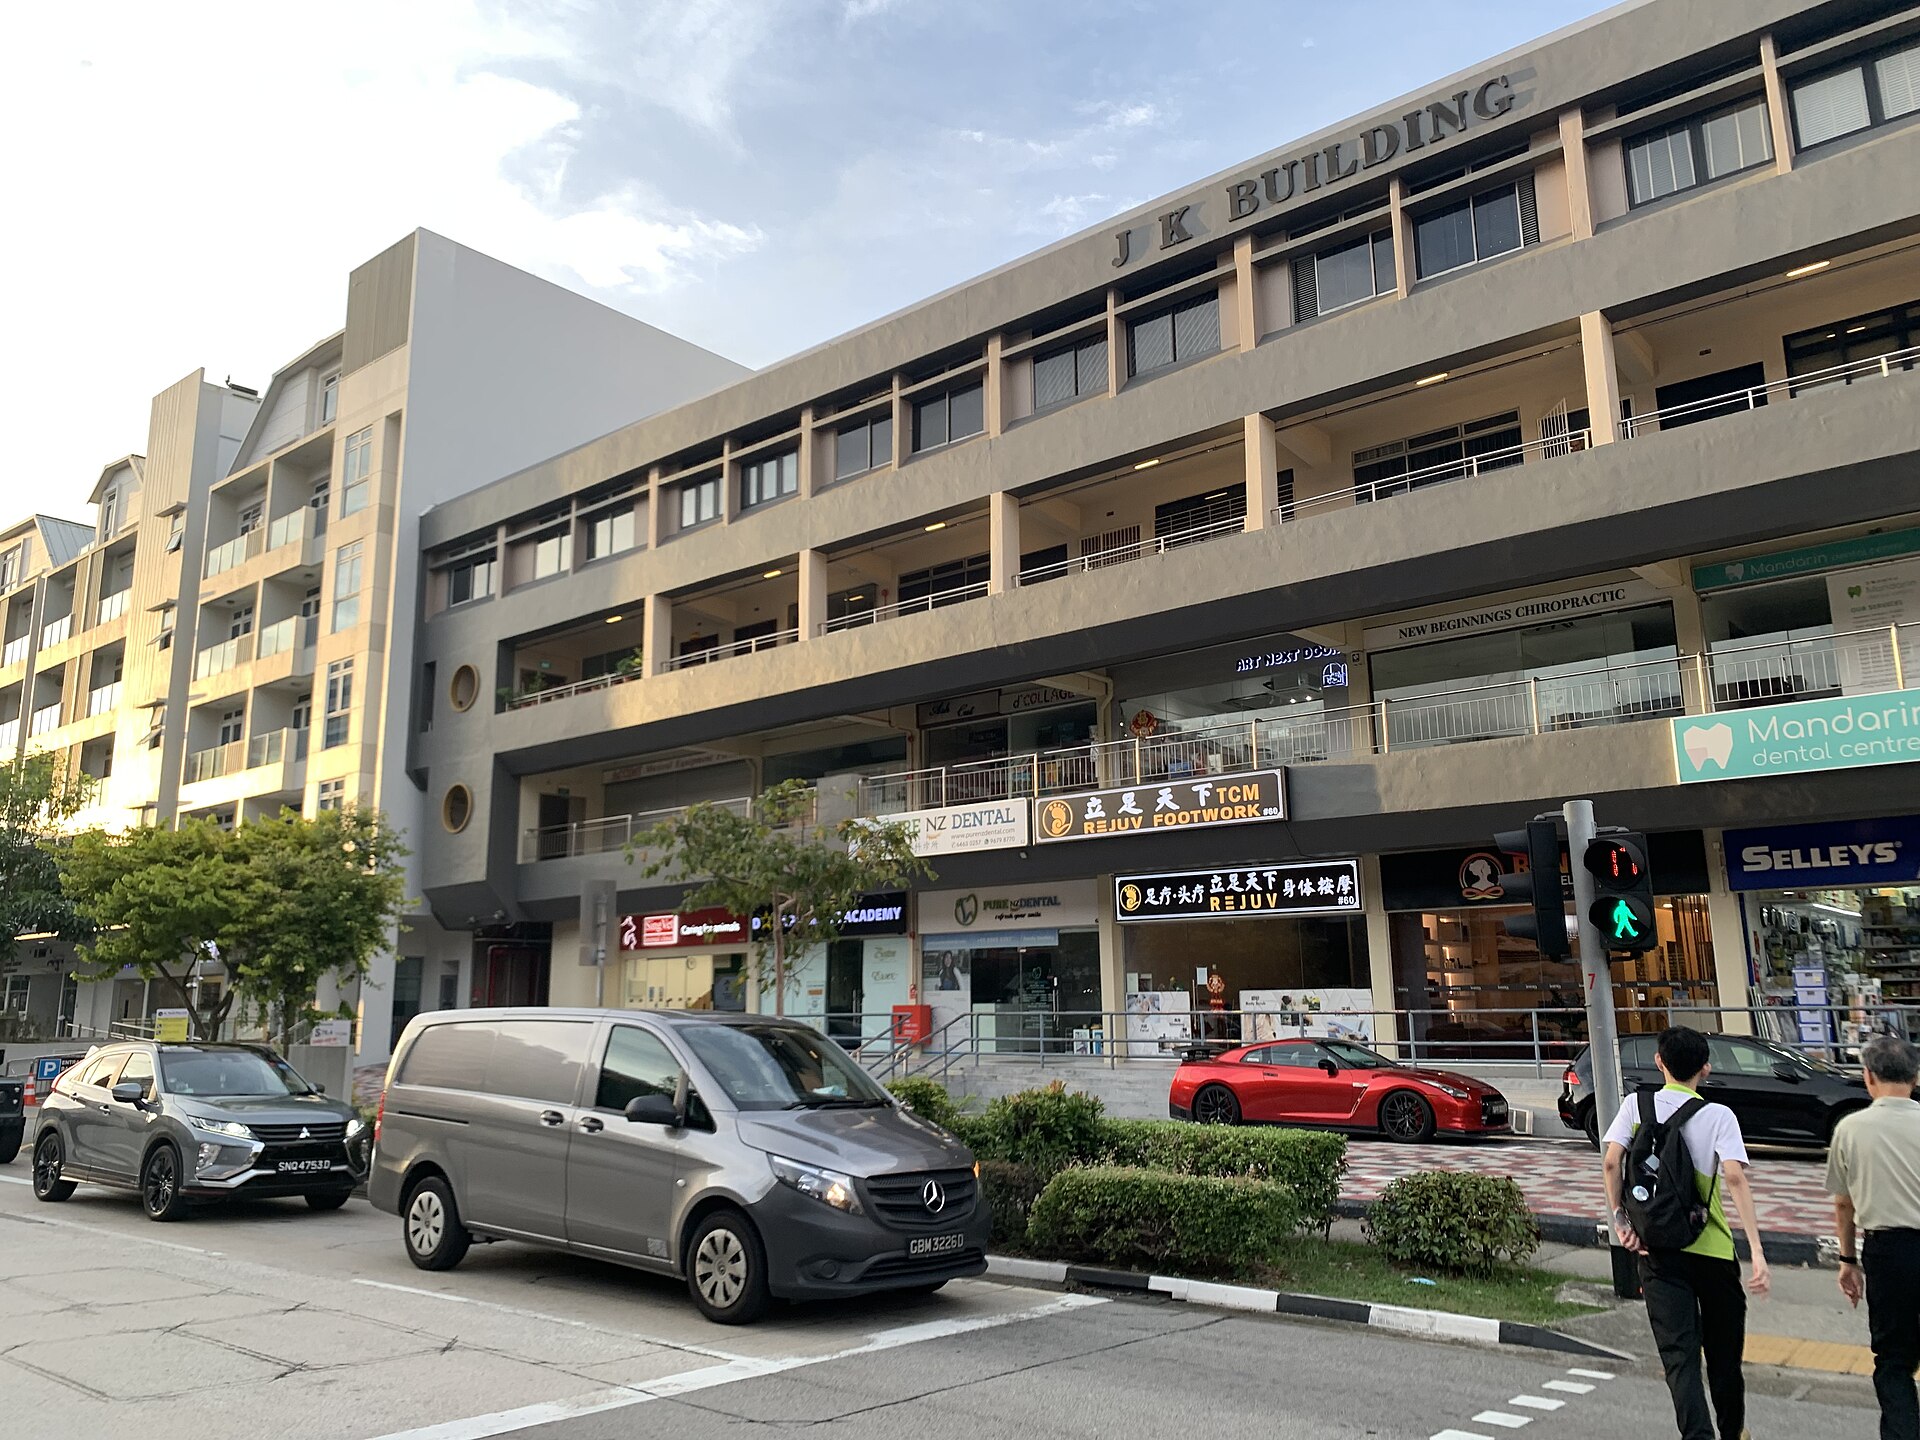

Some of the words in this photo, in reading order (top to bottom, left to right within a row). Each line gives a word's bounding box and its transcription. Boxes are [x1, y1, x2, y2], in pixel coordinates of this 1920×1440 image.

[1111, 229, 1131, 268] J
[1157, 205, 1193, 250] K
[1225, 75, 1515, 223] BUILDING
[1750, 554, 1828, 576] Mandarin
[1398, 624, 1427, 640] NEW
[1430, 609, 1512, 634] BEGINNINGS
[1515, 588, 1626, 619] CHIROPRACTIC
[1236, 655, 1262, 672] ART
[1752, 742, 1832, 767] dental
[1084, 783, 1213, 820] 立足天下
[1216, 783, 1260, 805] TCM
[926, 815, 947, 832] NZ
[951, 807, 1016, 830] DENTAL
[1083, 815, 1143, 835] REJUV
[1153, 803, 1261, 827] FOOTWORK
[1209, 870, 1278, 894] 立足天下
[1282, 874, 1354, 898] 身体按摩
[983, 899, 1009, 911] PURE
[1019, 896, 1062, 909] DENTAL
[1210, 893, 1278, 912] REJUV
[1337, 895, 1355, 906] #60
[844, 907, 902, 923] ACADEMY
[680, 924, 704, 936] Caring
[714, 921, 741, 933] animals
[1587, 973, 1596, 990] 7
[43, 1061, 57, 1077] P
[278, 1159, 331, 1172] SNQ4753D
[910, 1233, 964, 1255] GBM3226D
